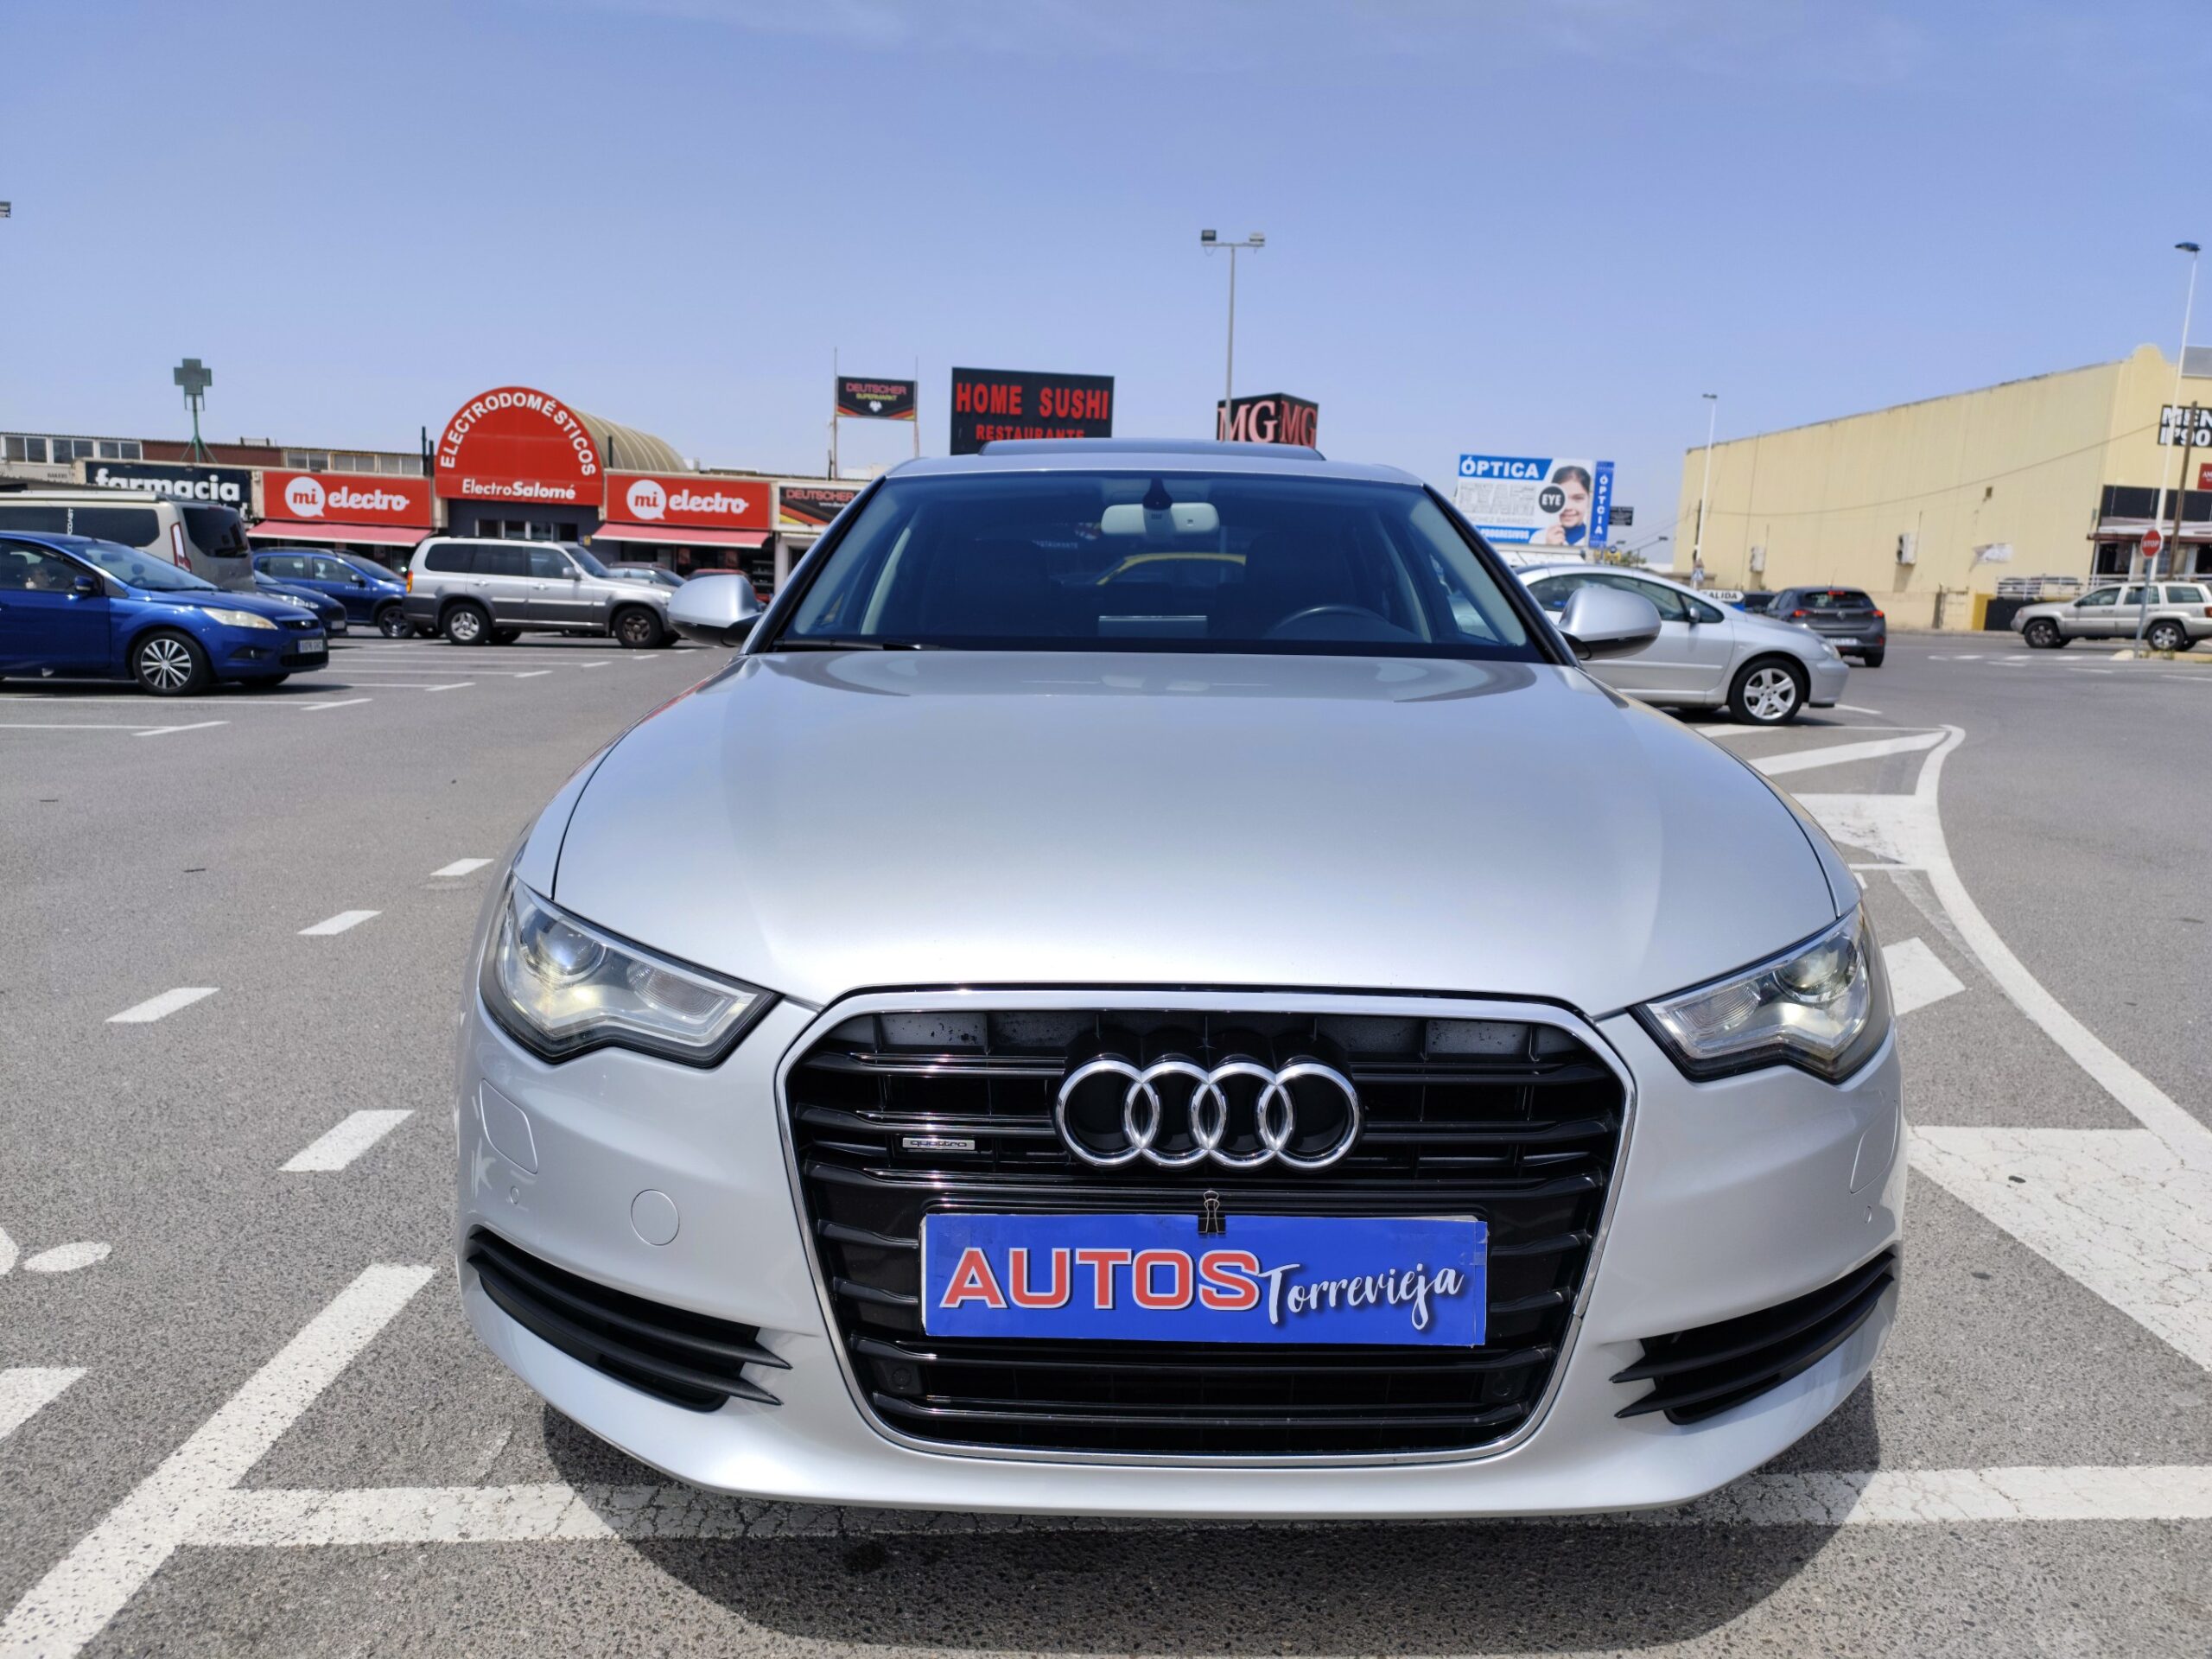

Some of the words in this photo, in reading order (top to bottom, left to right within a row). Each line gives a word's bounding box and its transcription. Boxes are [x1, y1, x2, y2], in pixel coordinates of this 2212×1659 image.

[846, 383, 906, 395] DEUTSCHER
[956, 382, 1023, 416] HOME
[1039, 386, 1109, 420] SUSHI
[440, 392, 596, 476] ELECTRODOMÉSTICOS
[976, 424, 1085, 441] RESTAURANTE
[1217, 399, 1278, 443] MG
[1280, 400, 1317, 448] MG
[1460, 456, 1540, 479] ÓPTICA
[94, 467, 241, 502] farmacia
[461, 478, 576, 500] ElectroSalomé
[785, 488, 854, 502] DEUTSCHER
[293, 488, 319, 505] mi
[327, 486, 410, 512] electro
[634, 491, 658, 508] mi
[669, 488, 750, 514] electro
[1541, 493, 1561, 506] EYE
[2143, 539, 2160, 548] STOP
[939, 1247, 1262, 1311] AUTOS
[1258, 1262, 1465, 1331] Torrevieja
